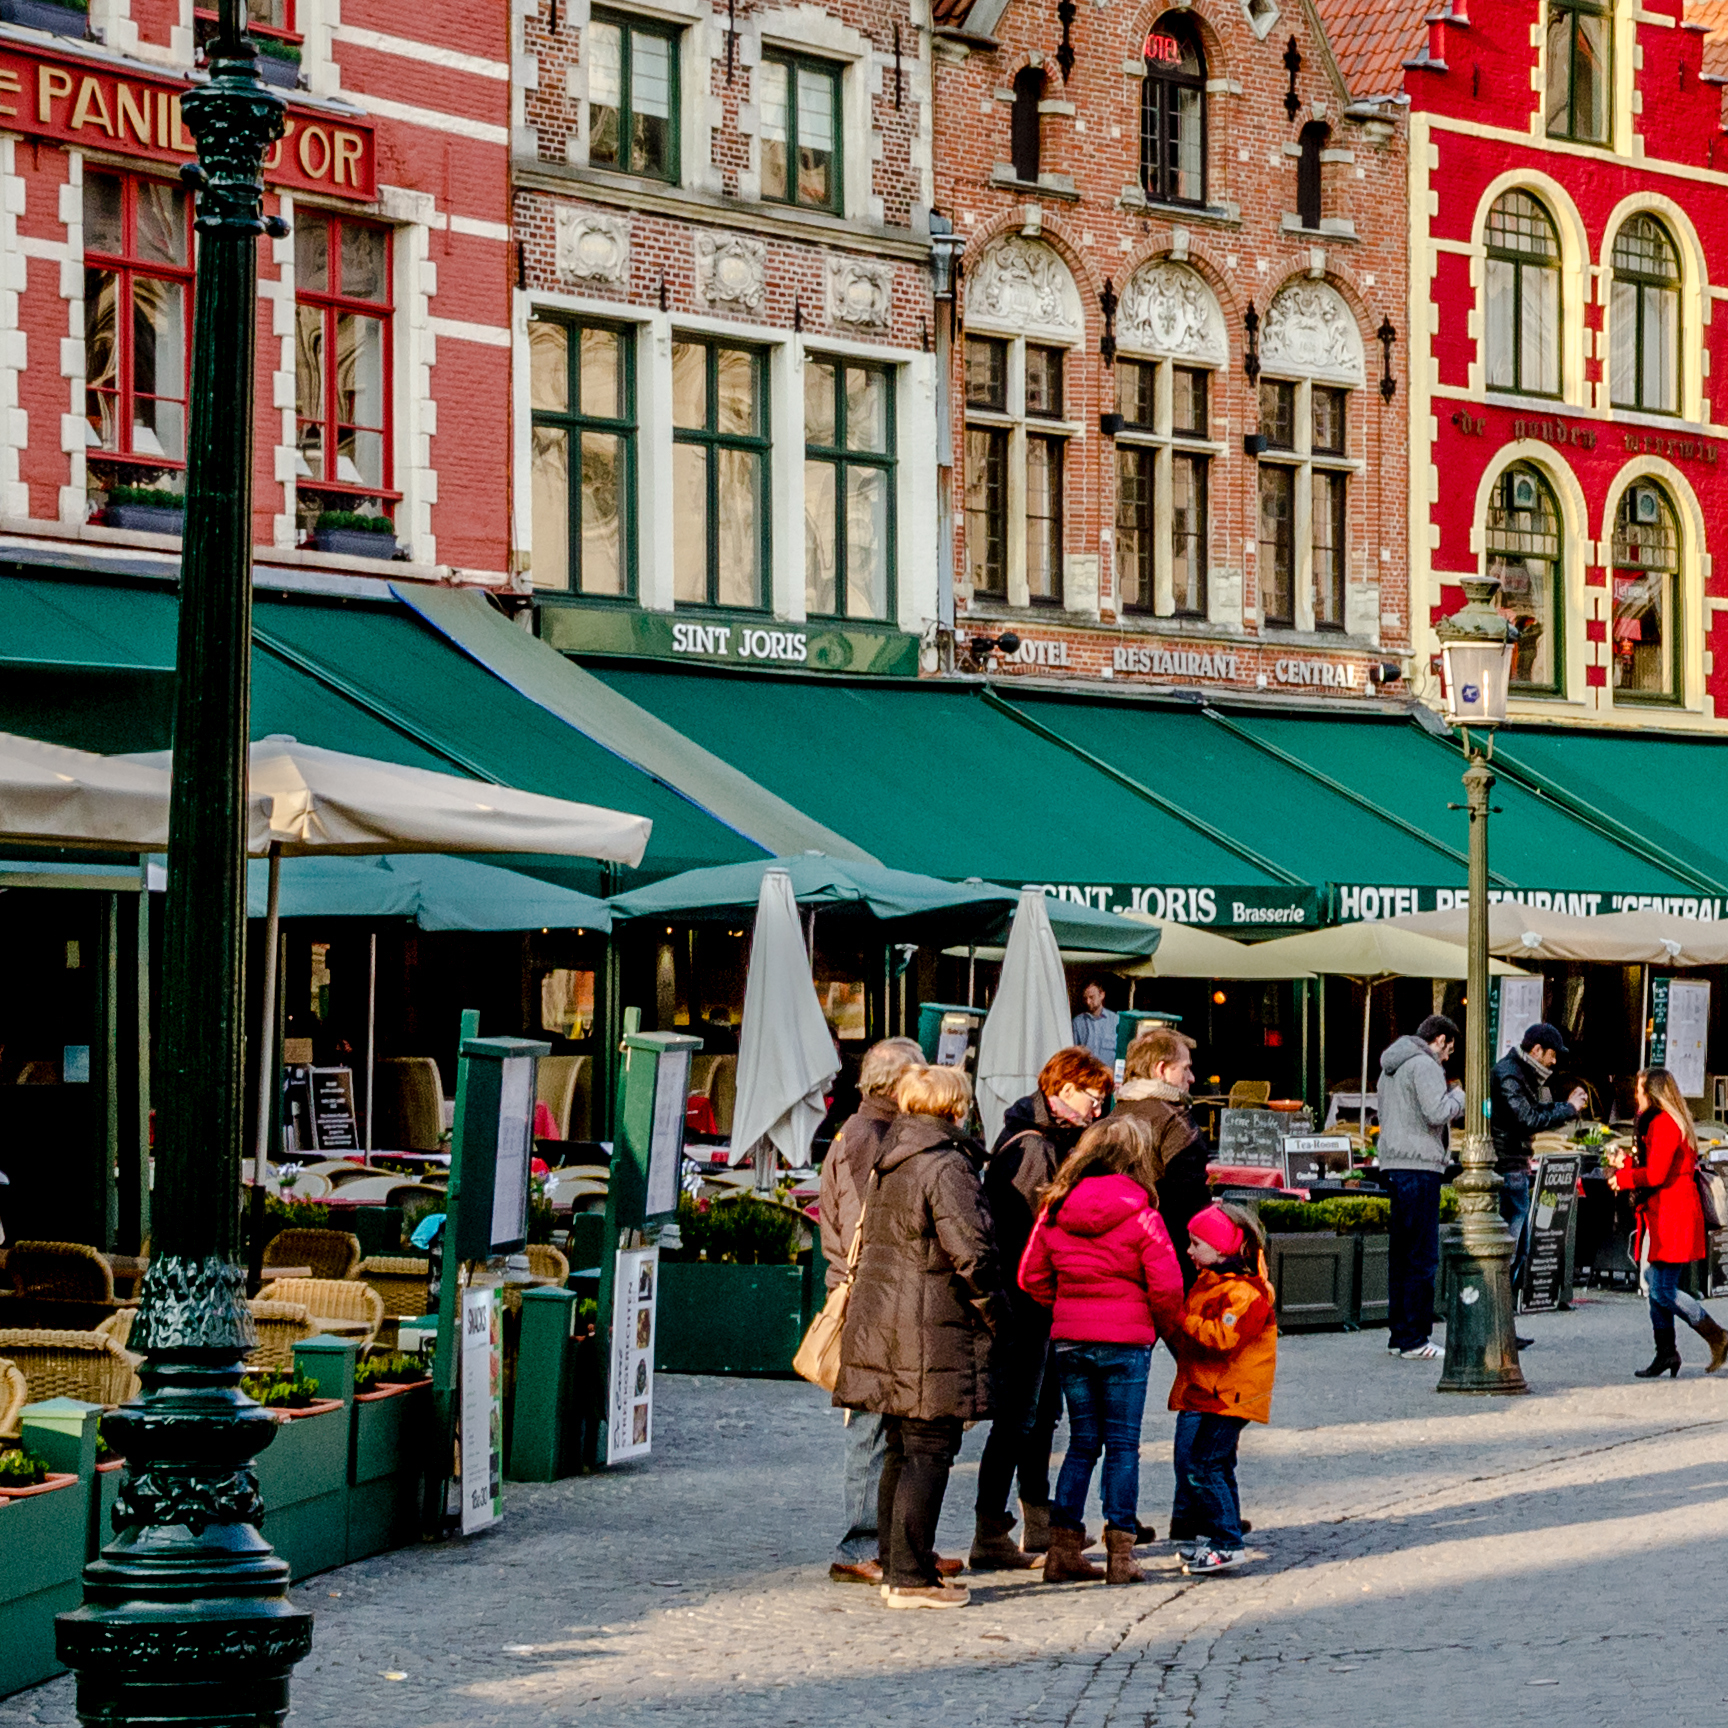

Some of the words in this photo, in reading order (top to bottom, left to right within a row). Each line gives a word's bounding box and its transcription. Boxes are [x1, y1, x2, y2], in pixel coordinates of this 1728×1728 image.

[672, 623, 730, 655] SINT
[738, 629, 807, 661] JORIS
[1113, 646, 1238, 679] RESTAURANT
[1274, 658, 1357, 688] CENTRAL
[1232, 903, 1304, 923] Brasserie
[1544, 1173, 1573, 1186] LOCALES
